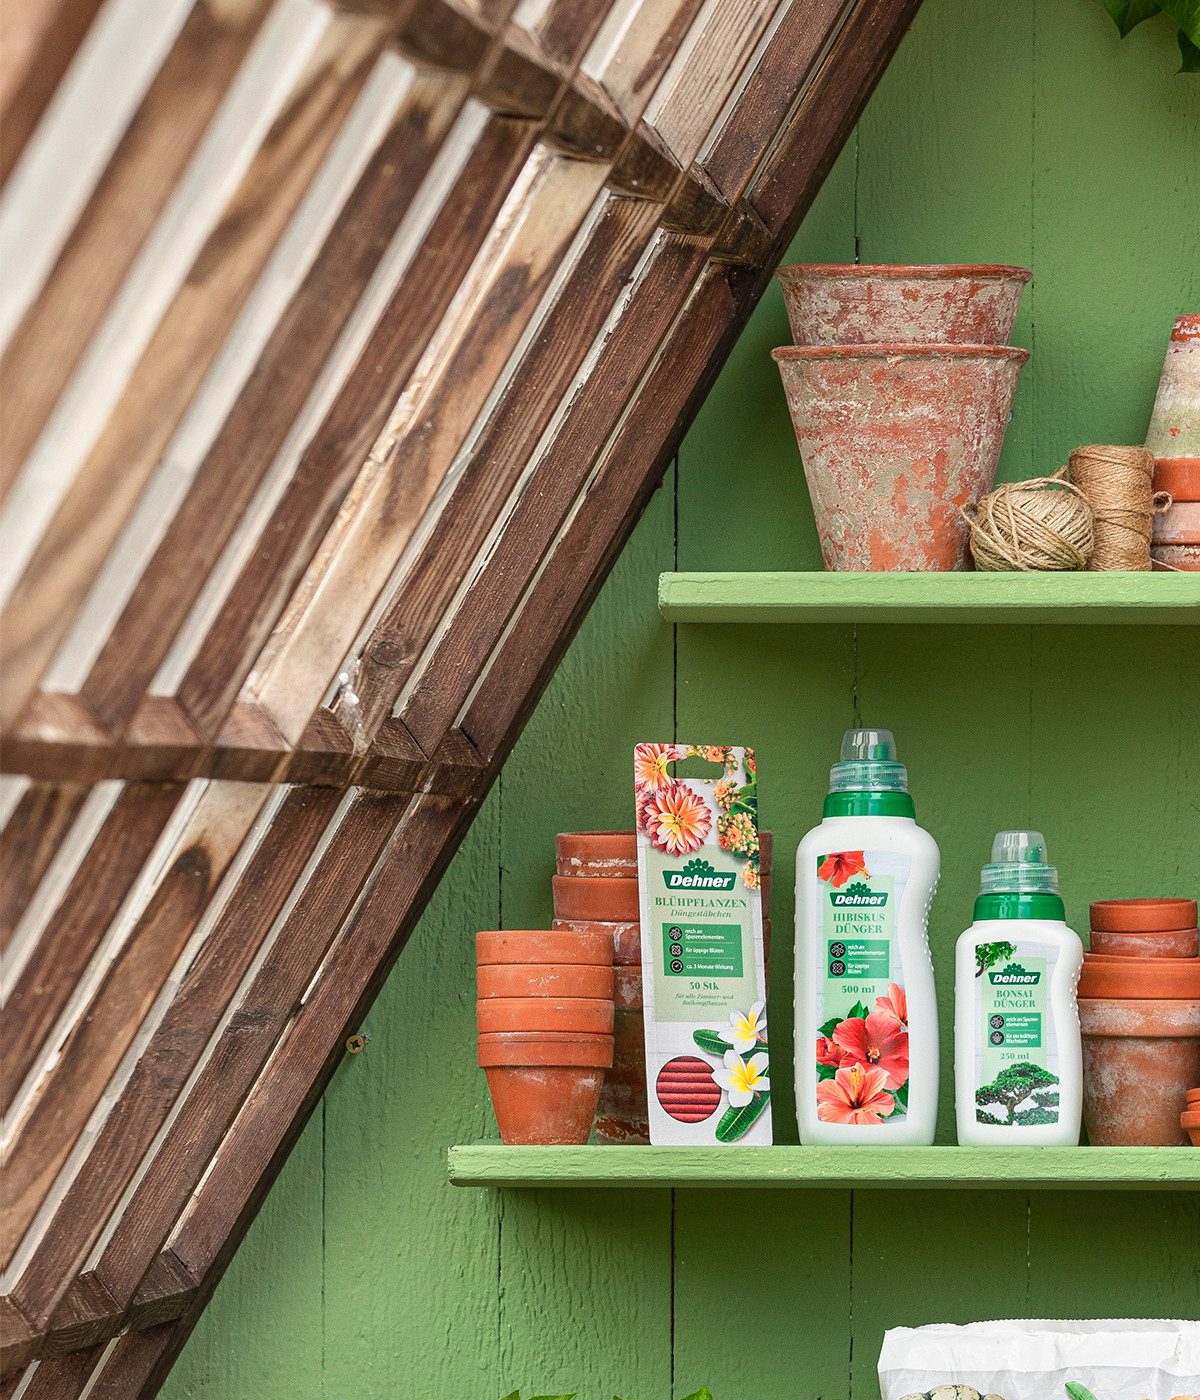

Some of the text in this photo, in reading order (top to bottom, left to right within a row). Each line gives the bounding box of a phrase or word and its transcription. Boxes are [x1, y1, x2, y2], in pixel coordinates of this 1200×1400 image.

[670, 874, 732, 888] Dehner
[655, 896, 747, 908] BLÜHPFLANZEN
[835, 894, 884, 905] Dehner
[671, 909, 732, 919] Düngestäbchen
[833, 913, 885, 922] HIBISKUS
[836, 922, 883, 934] DÜNGER
[994, 974, 1037, 983] Dehner
[690, 982, 719, 990] 50 Stk
[842, 985, 875, 993] 500 ml
[997, 990, 1033, 998] BONSAI
[994, 998, 1036, 1008] DÜNGER
[1001, 1052, 1030, 1060] 250 ml
